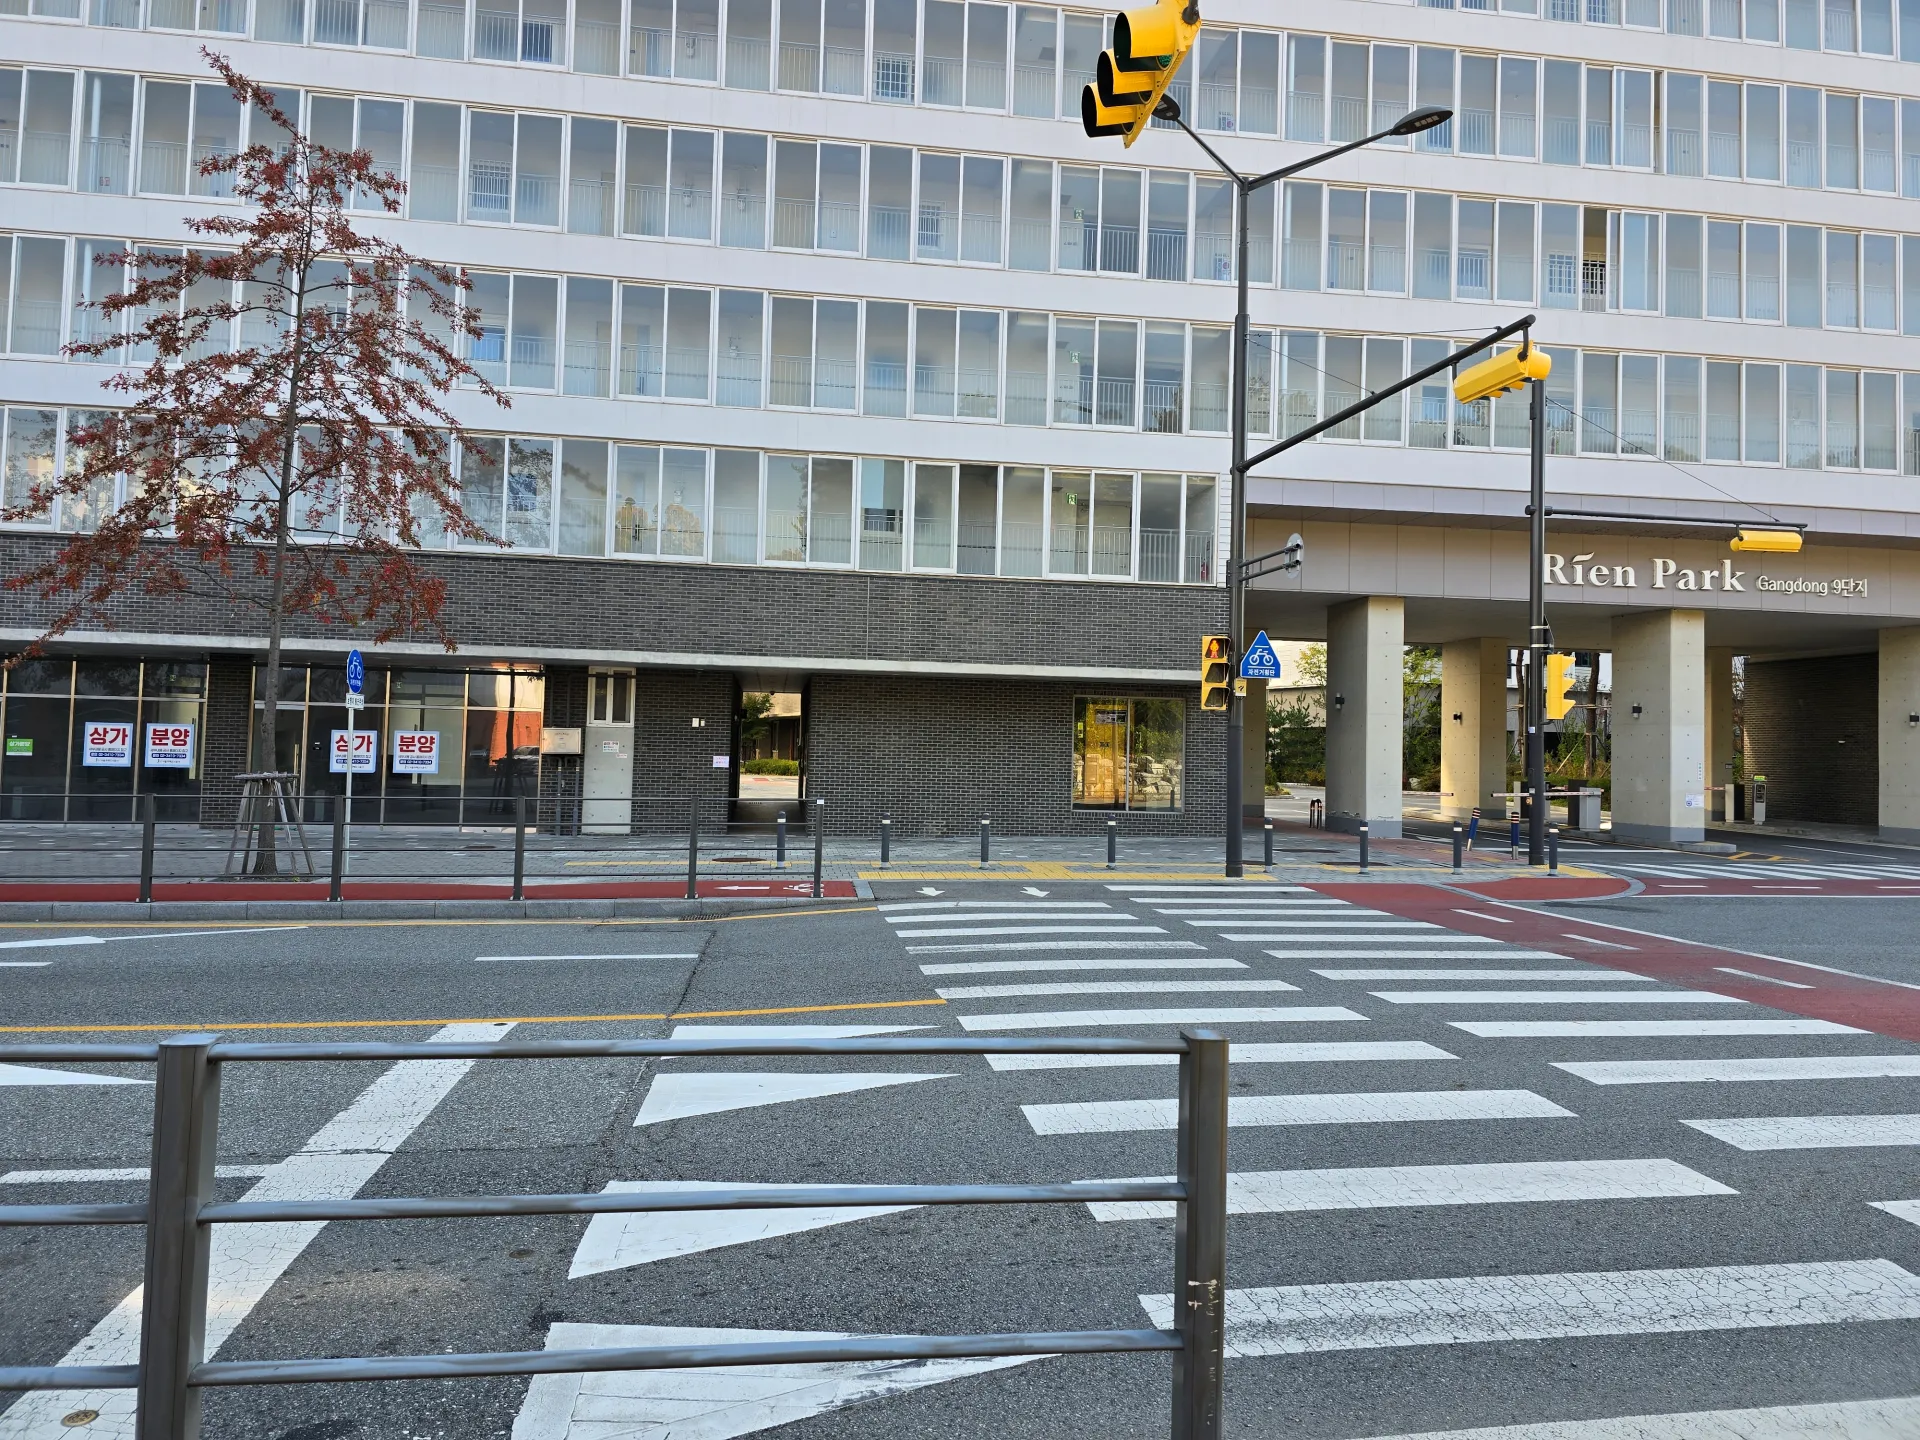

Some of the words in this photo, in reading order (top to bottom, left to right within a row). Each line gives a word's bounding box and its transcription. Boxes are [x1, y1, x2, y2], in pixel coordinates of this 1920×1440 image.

[1652, 558, 1746, 592] Park
[1757, 575, 1828, 597] Gangdong
[1832, 578, 1868, 598] 9단지
[1247, 668, 1275, 677] 자전거횡단
[89, 727, 128, 746] 상가
[151, 728, 190, 747] 분양
[398, 735, 435, 753] 분양
